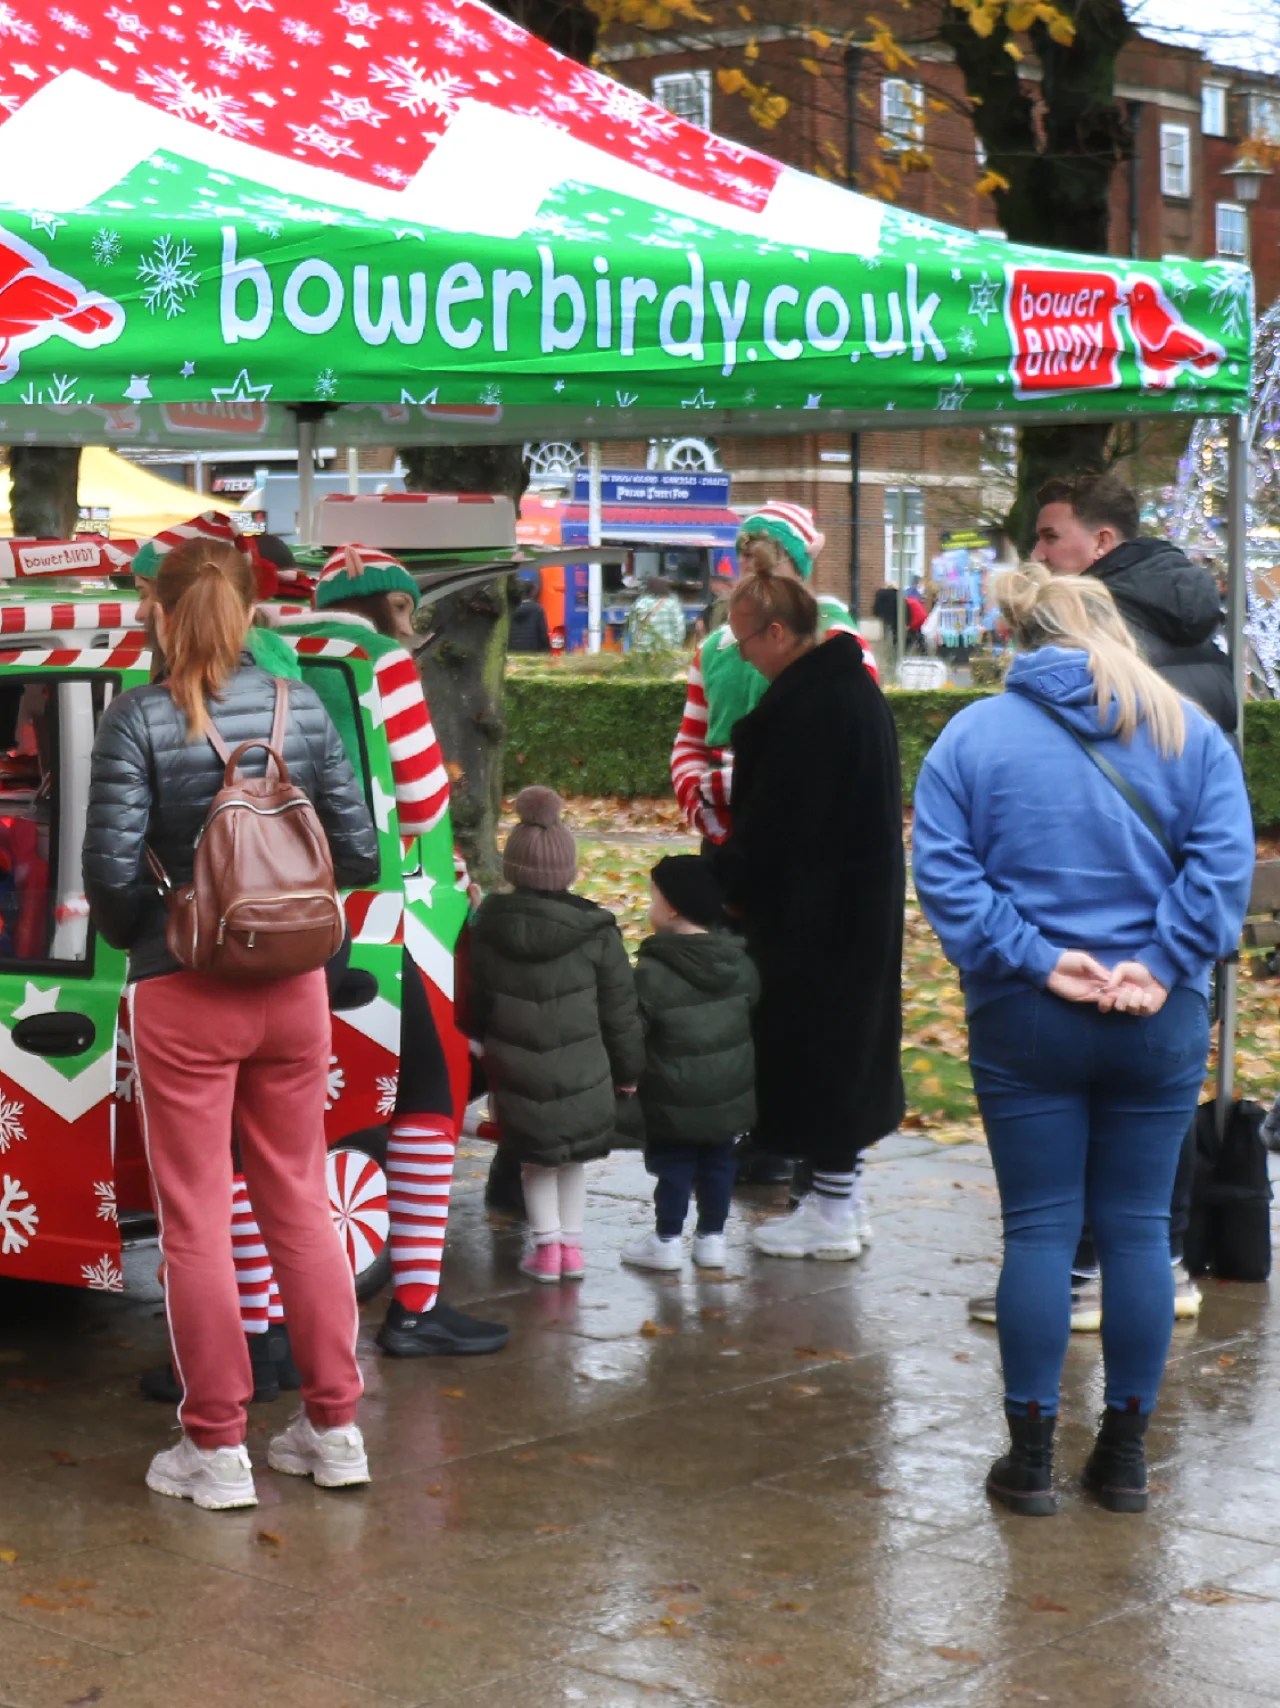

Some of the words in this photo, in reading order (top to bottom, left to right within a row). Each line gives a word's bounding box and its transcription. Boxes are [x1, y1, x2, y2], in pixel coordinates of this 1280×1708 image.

[221, 225, 948, 378] bowerbirdy.co.uk
[1020, 283, 1105, 322] bower
[1023, 321, 1104, 376] BIRDY
